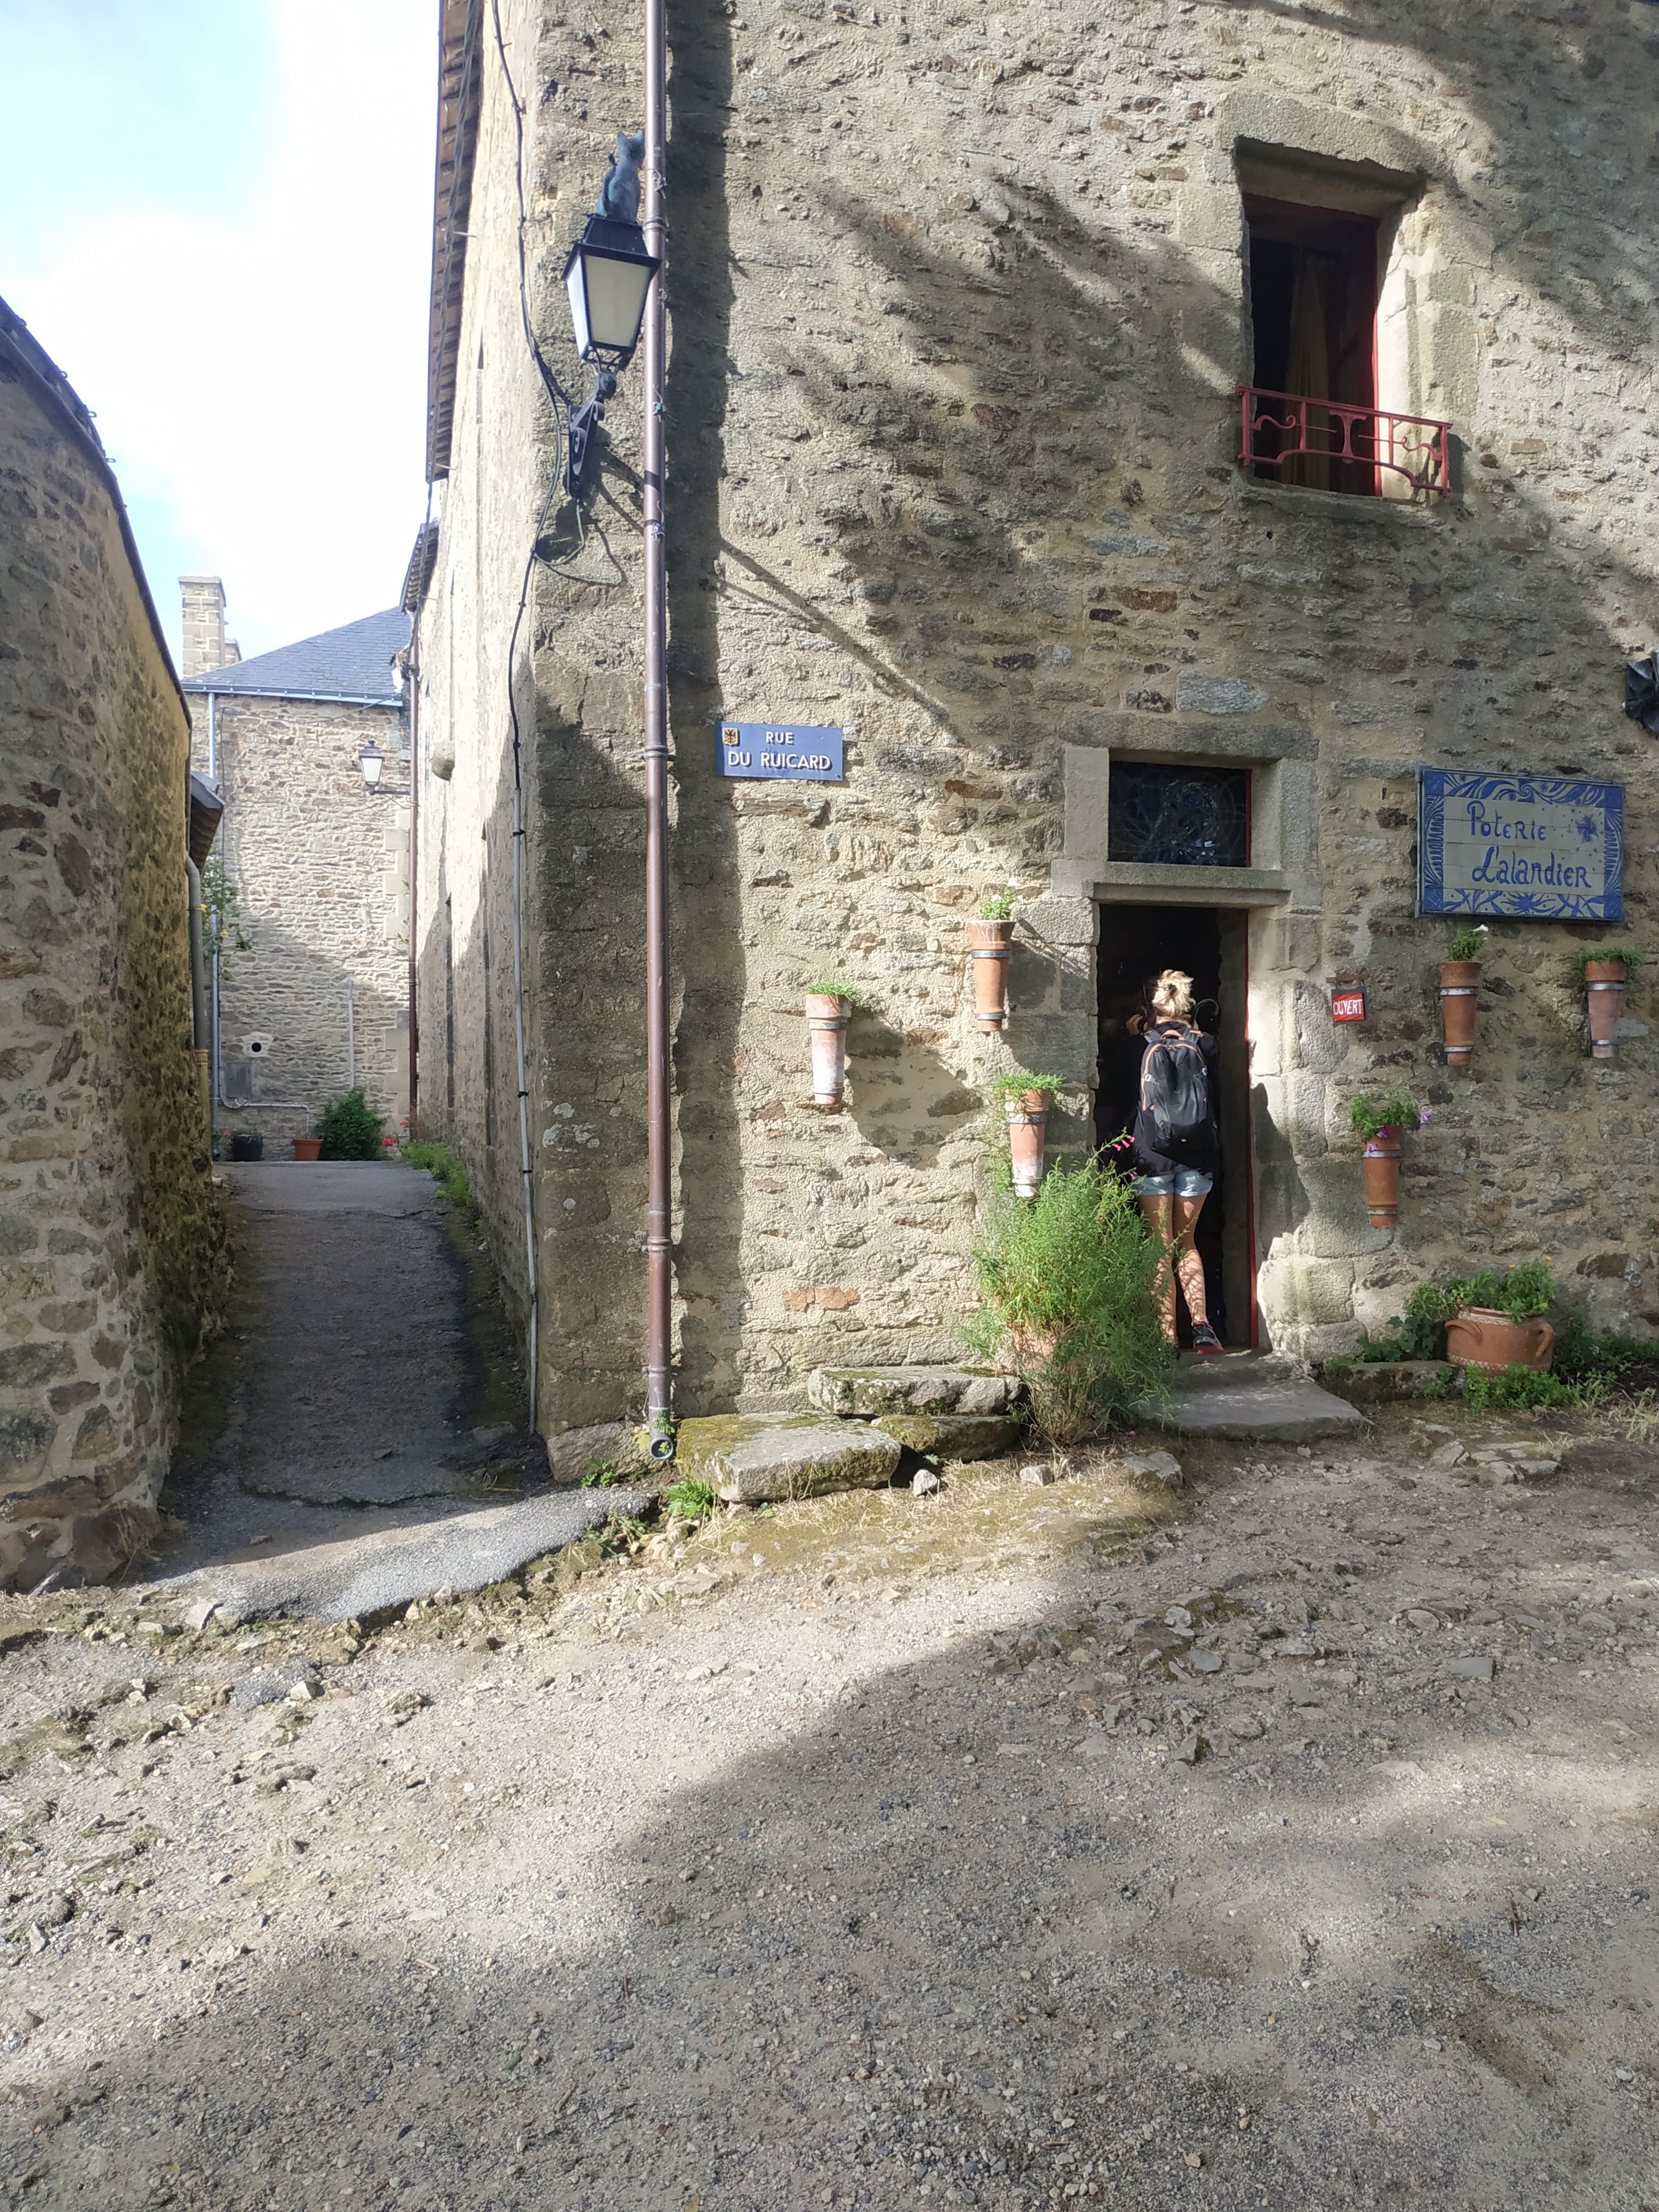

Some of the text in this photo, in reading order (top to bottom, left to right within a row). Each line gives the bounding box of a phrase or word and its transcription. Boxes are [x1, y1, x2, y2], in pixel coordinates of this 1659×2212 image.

[765, 731, 795, 744] RUE
[728, 751, 831, 770] DU RUICARD
[1333, 999, 1363, 1015] OUVERT
